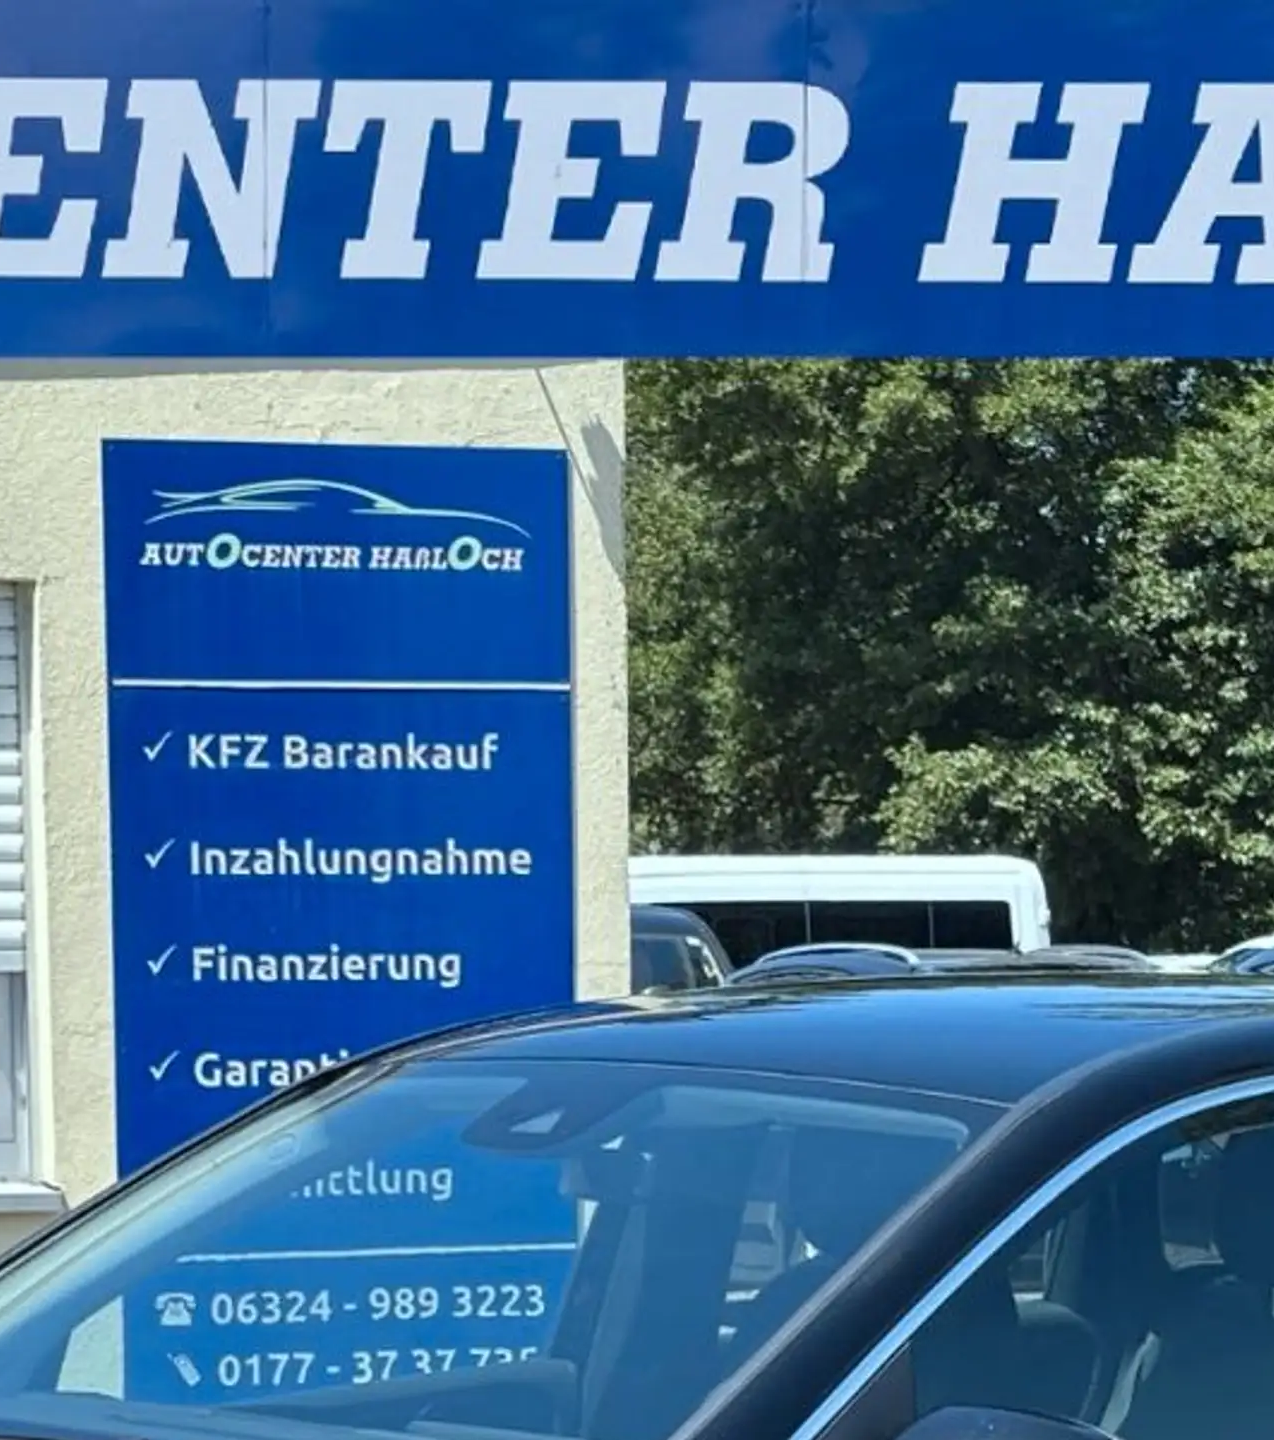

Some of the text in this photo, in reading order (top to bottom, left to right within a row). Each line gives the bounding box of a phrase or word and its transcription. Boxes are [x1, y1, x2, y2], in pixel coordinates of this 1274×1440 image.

[139, 532, 525, 572] AUTOCENTER HAßLOCH
[188, 732, 499, 770] KFZ Barankauf
[190, 838, 532, 883] Inzahlungnahme
[192, 944, 462, 987] Finanzierung
[211, 1290, 333, 1325] 06324
[369, 1287, 439, 1320] 989
[452, 1284, 545, 1318] 3223
[218, 1353, 316, 1387] 0177
[352, 1350, 398, 1384] 37
